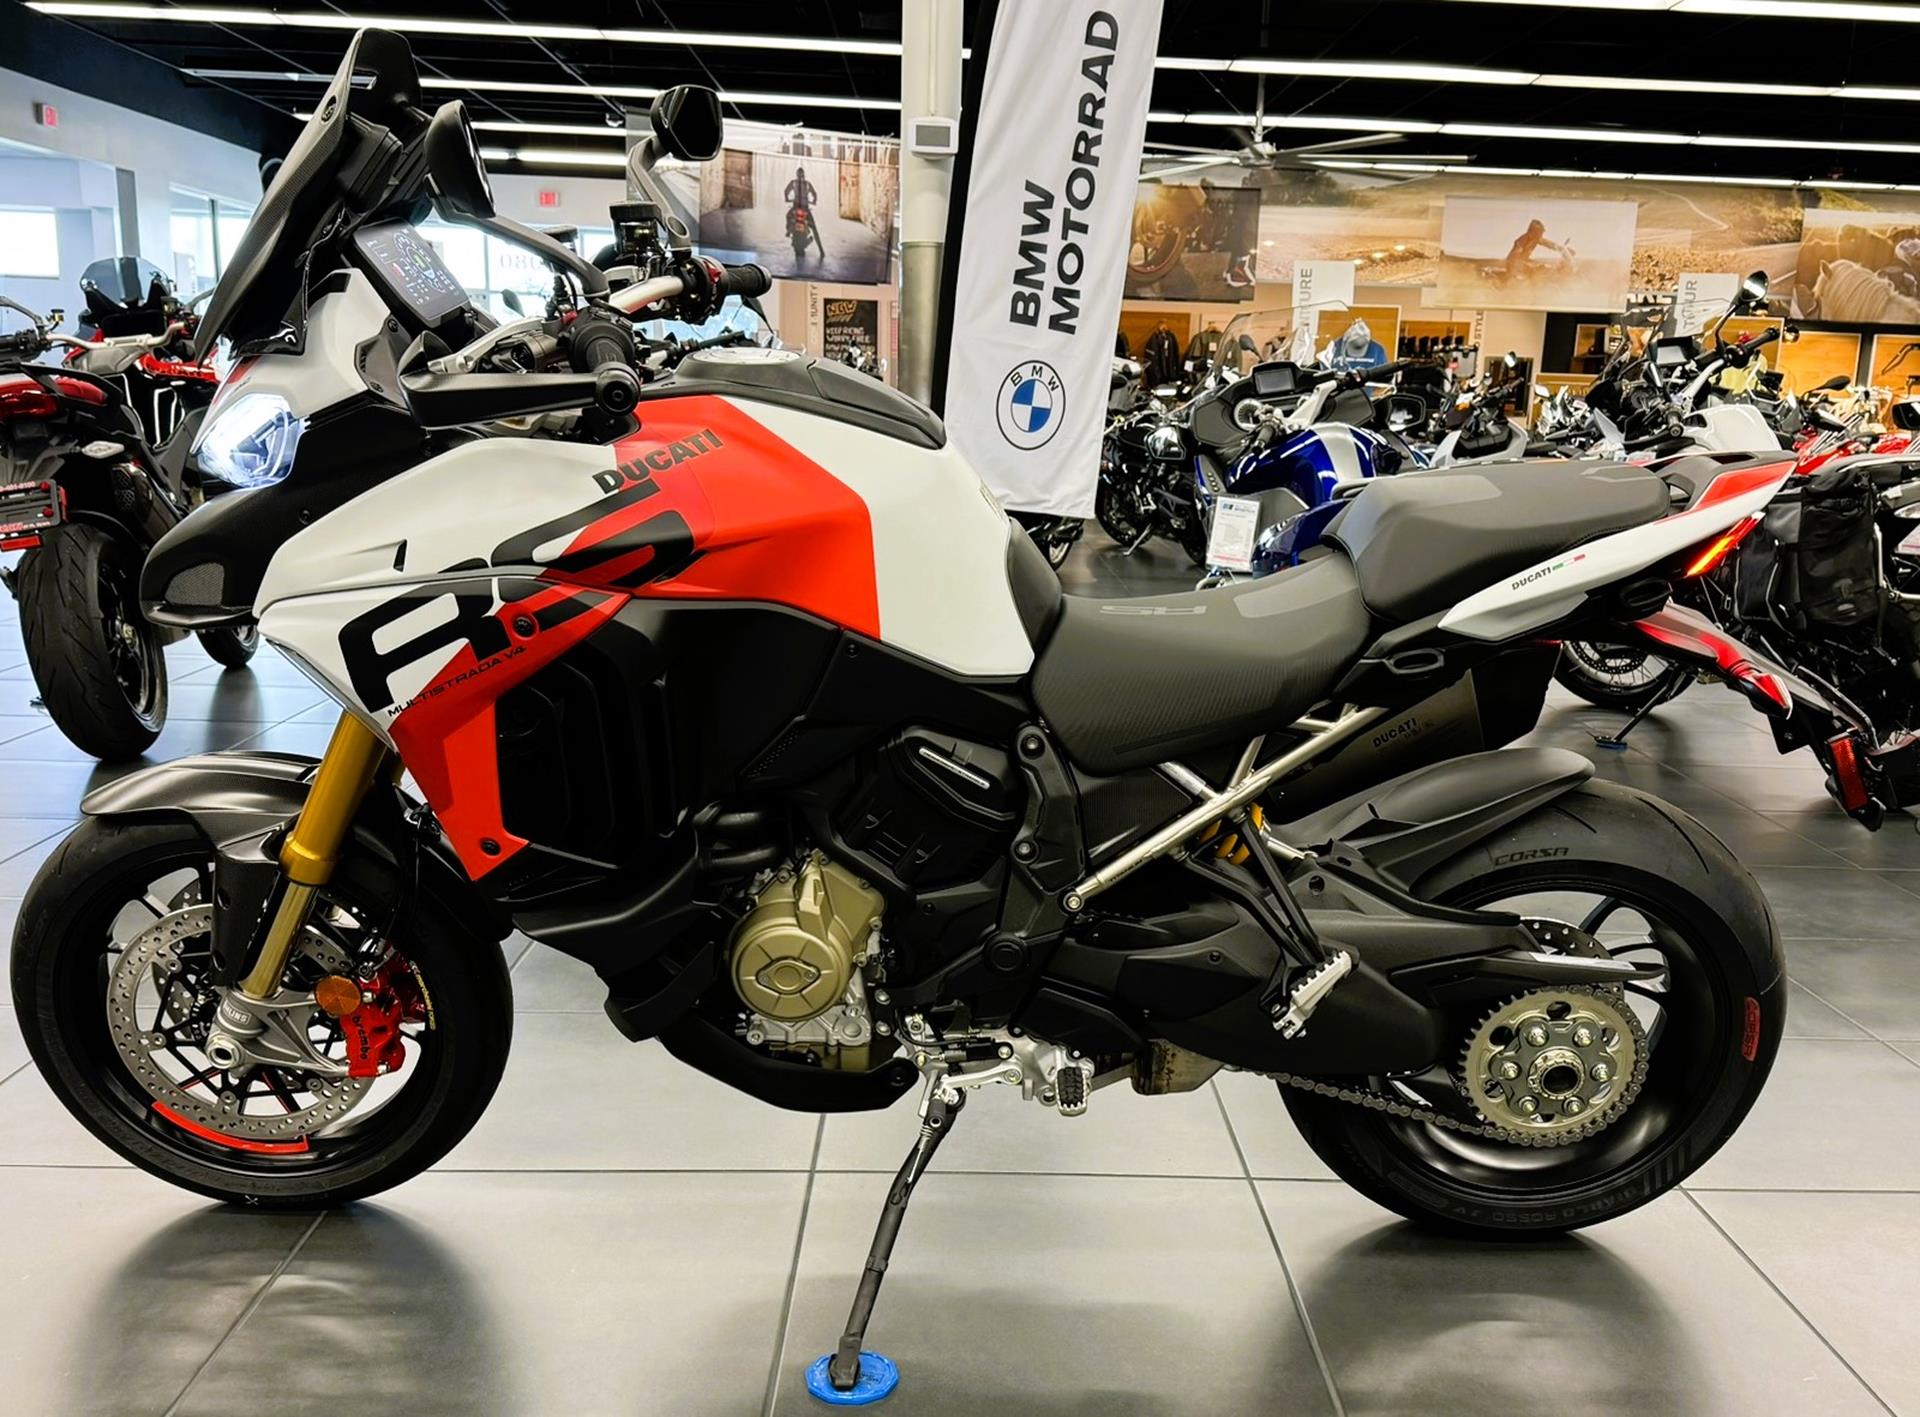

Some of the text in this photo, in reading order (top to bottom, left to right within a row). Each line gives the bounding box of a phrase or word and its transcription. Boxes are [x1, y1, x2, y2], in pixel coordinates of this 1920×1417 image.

[1048, 10, 1119, 335] MOTORRAD
[1010, 179, 1055, 327] BMW
[1010, 364, 1060, 392] BMW
[592, 428, 724, 495] DUCATI
[1511, 566, 1552, 591] DUCATI
[387, 645, 528, 718] MULTISTRADA V4
[1372, 717, 1417, 748] DUCATI
[1495, 847, 1570, 867] CORSA
[351, 1014, 369, 1061] brembo
[1491, 1210, 1558, 1224] ROSSO
